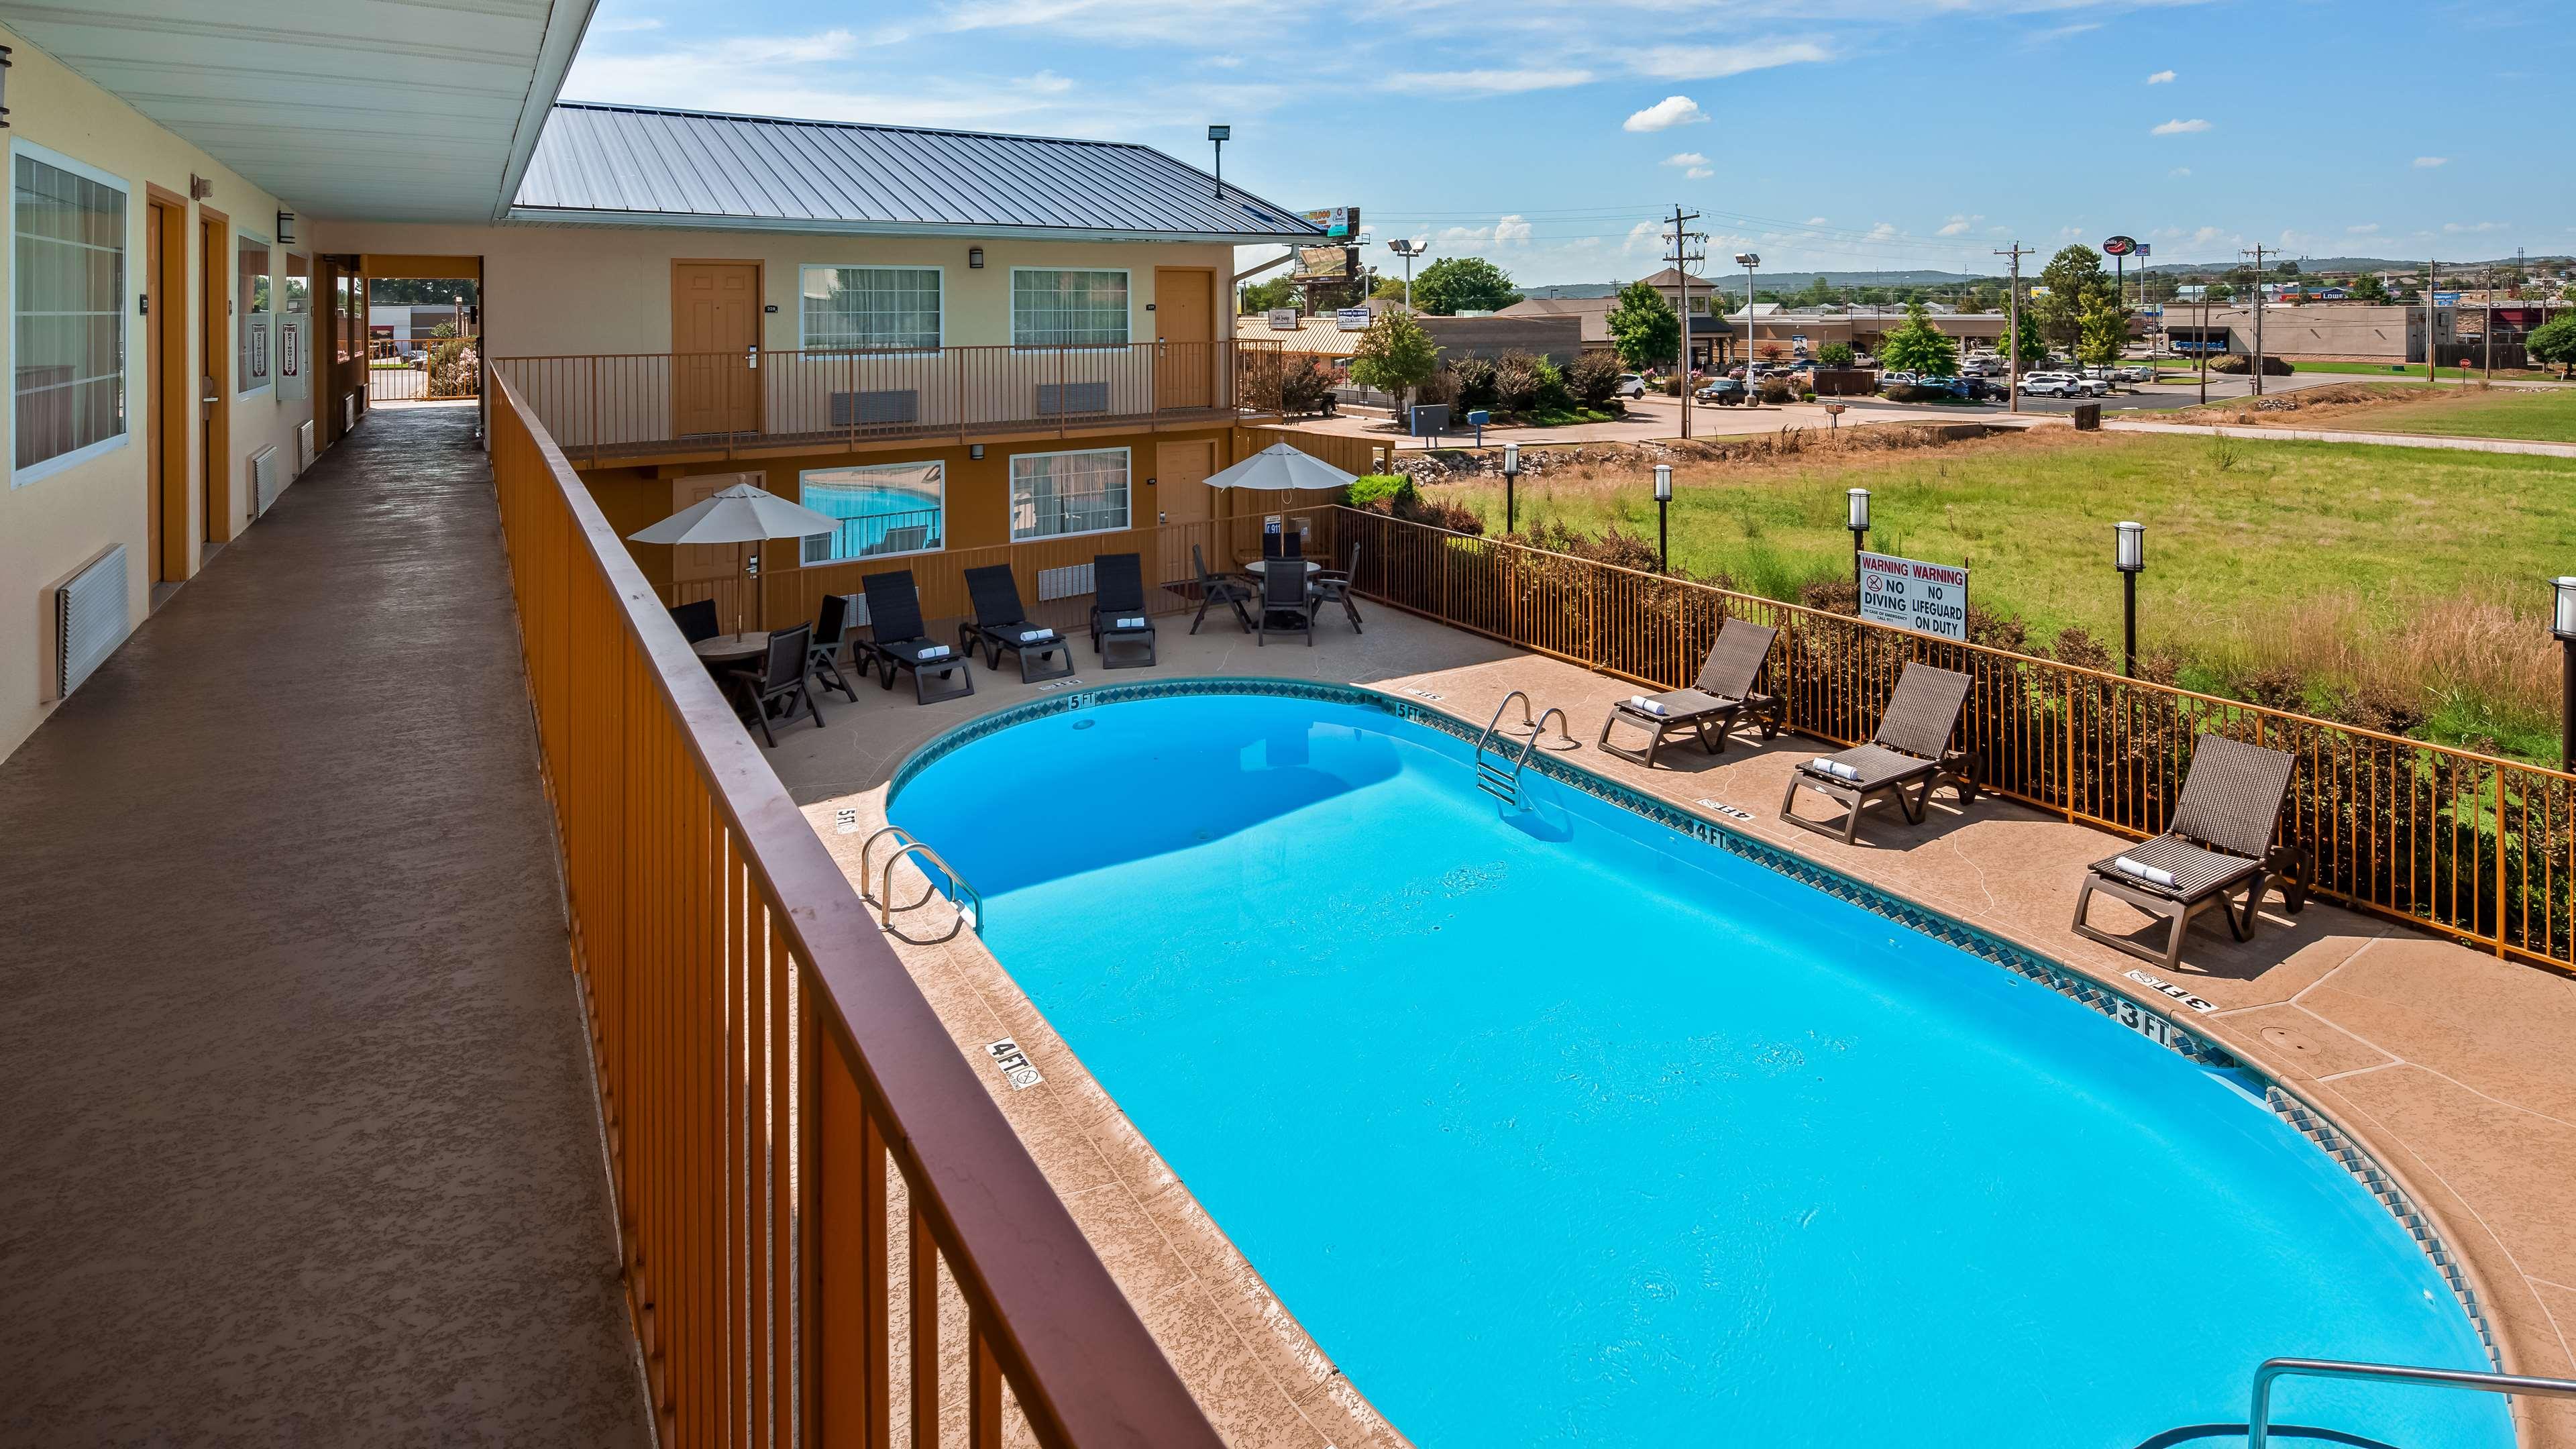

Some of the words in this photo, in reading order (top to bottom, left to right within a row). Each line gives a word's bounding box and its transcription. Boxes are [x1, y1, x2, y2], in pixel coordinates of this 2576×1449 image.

[1271, 524, 1281, 533] 911
[1862, 557, 1908, 576] WARNING
[1913, 565, 1963, 586] WARNING
[1886, 580, 1904, 594] NO
[1928, 586, 1943, 600] NO
[1865, 592, 1906, 611] DIVING
[1885, 613, 1907, 621] EMERGENCY
[1913, 599, 1962, 621] LIFEGUARD
[1916, 616, 1929, 631] ON
[1933, 619, 1958, 636] DUTY
[1071, 696, 1079, 709] 5
[1083, 692, 1094, 704] FT
[1398, 704, 1405, 717] 5
[1696, 824, 1708, 842] 4
[2153, 982, 2190, 998] FT.
[2186, 998, 2212, 1010] 3
[2121, 1002, 2139, 1029] 3
[2145, 1015, 2170, 1048] FT.
[992, 1043, 1016, 1056] 4
[998, 1053, 1029, 1074] FT.
[1011, 1079, 1022, 1090] DIVING
